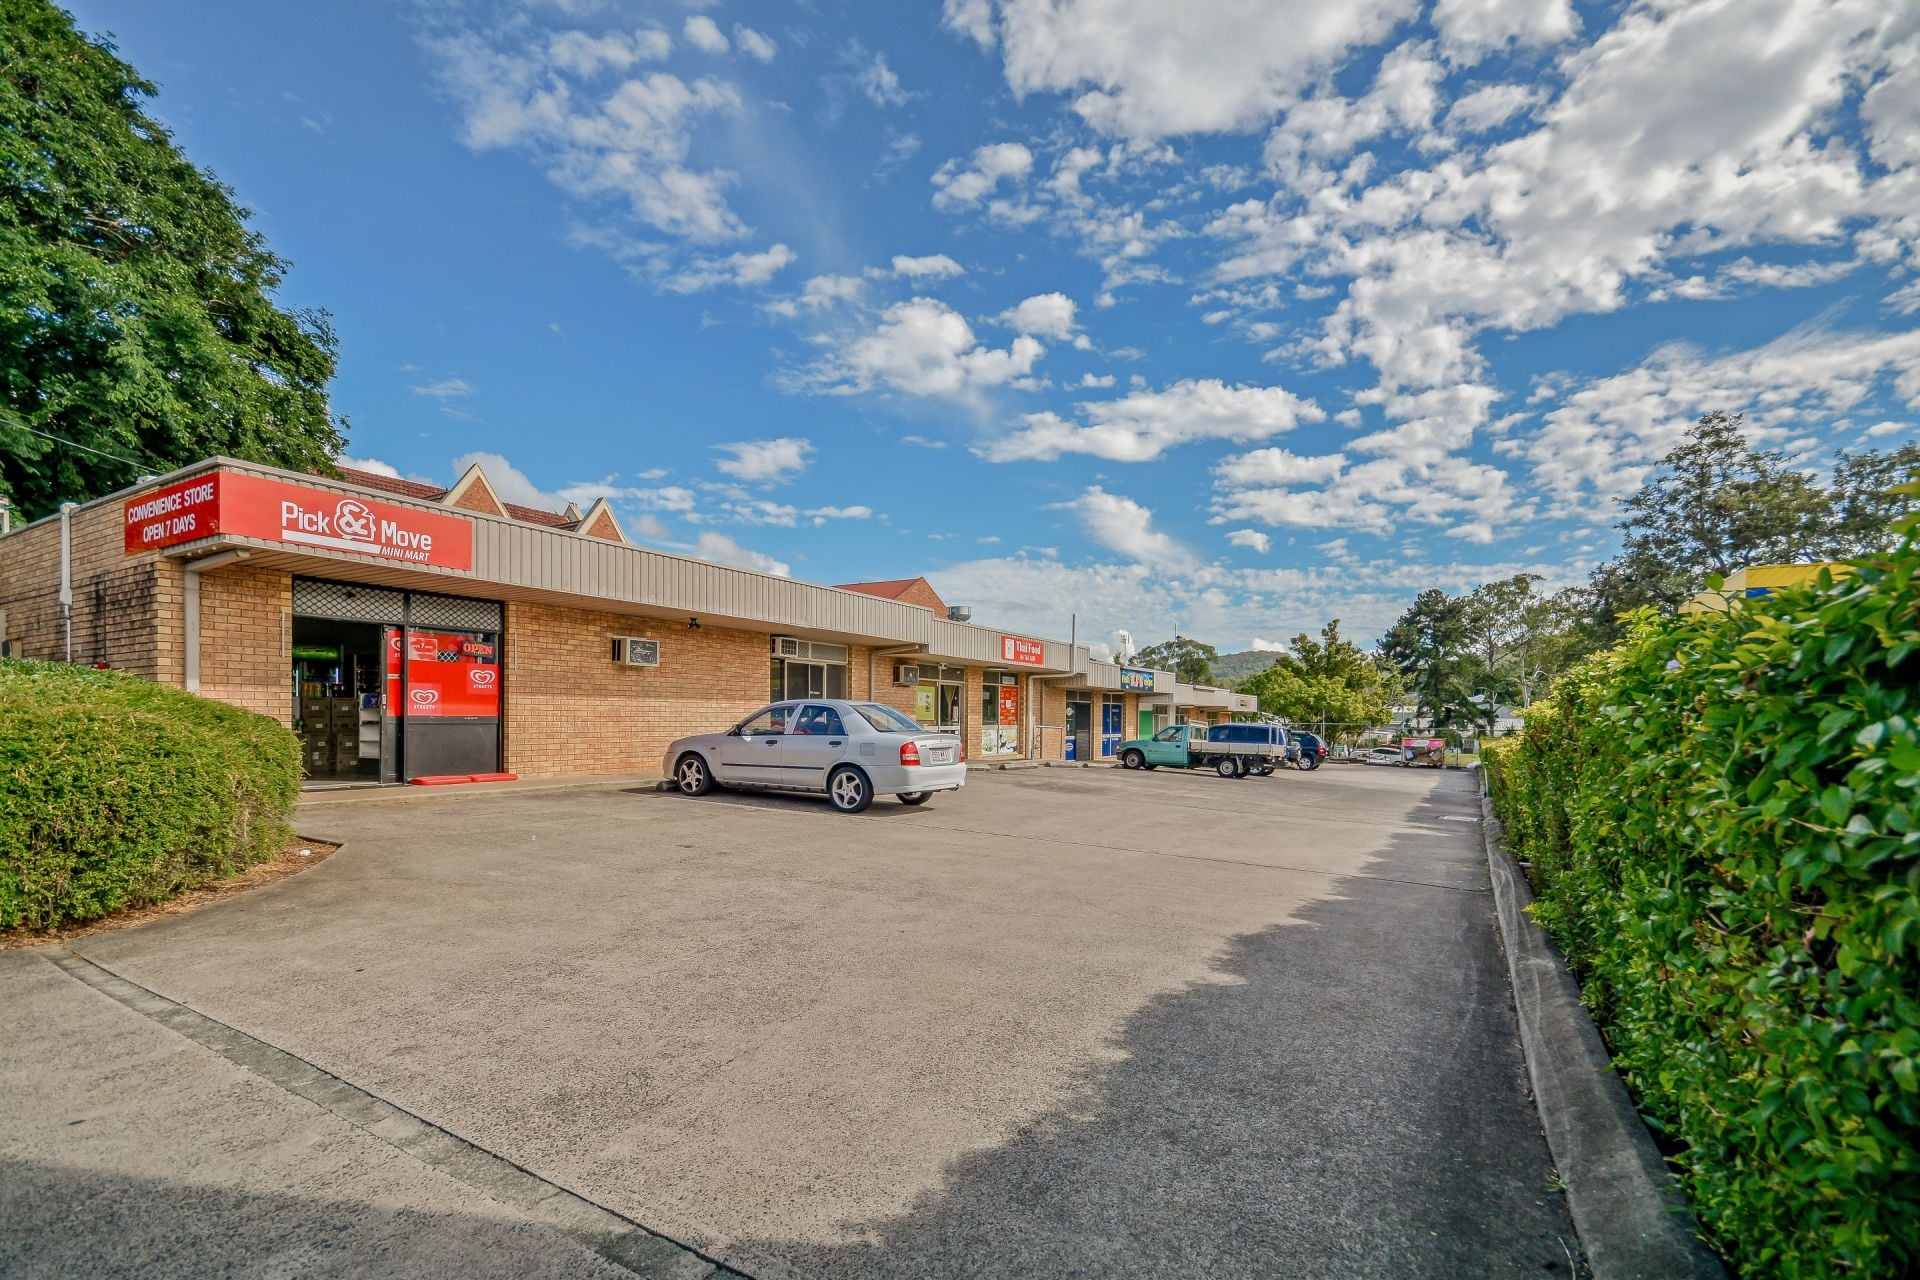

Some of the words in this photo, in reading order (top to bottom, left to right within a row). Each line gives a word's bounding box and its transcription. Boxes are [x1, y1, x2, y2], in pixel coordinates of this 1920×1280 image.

[128, 493, 182, 524] CONVENIENCE
[184, 482, 214, 507] STORE
[143, 522, 164, 543] OPEN
[165, 520, 171, 537] 7
[172, 514, 196, 535] DAYS
[281, 501, 331, 534] Pick
[381, 520, 432, 550] Move
[382, 546, 403, 558] MINI
[404, 552, 430, 562] MART
[463, 642, 494, 655] OPEN
[1015, 640, 1028, 653] Thai
[1028, 643, 1041, 655] Food
